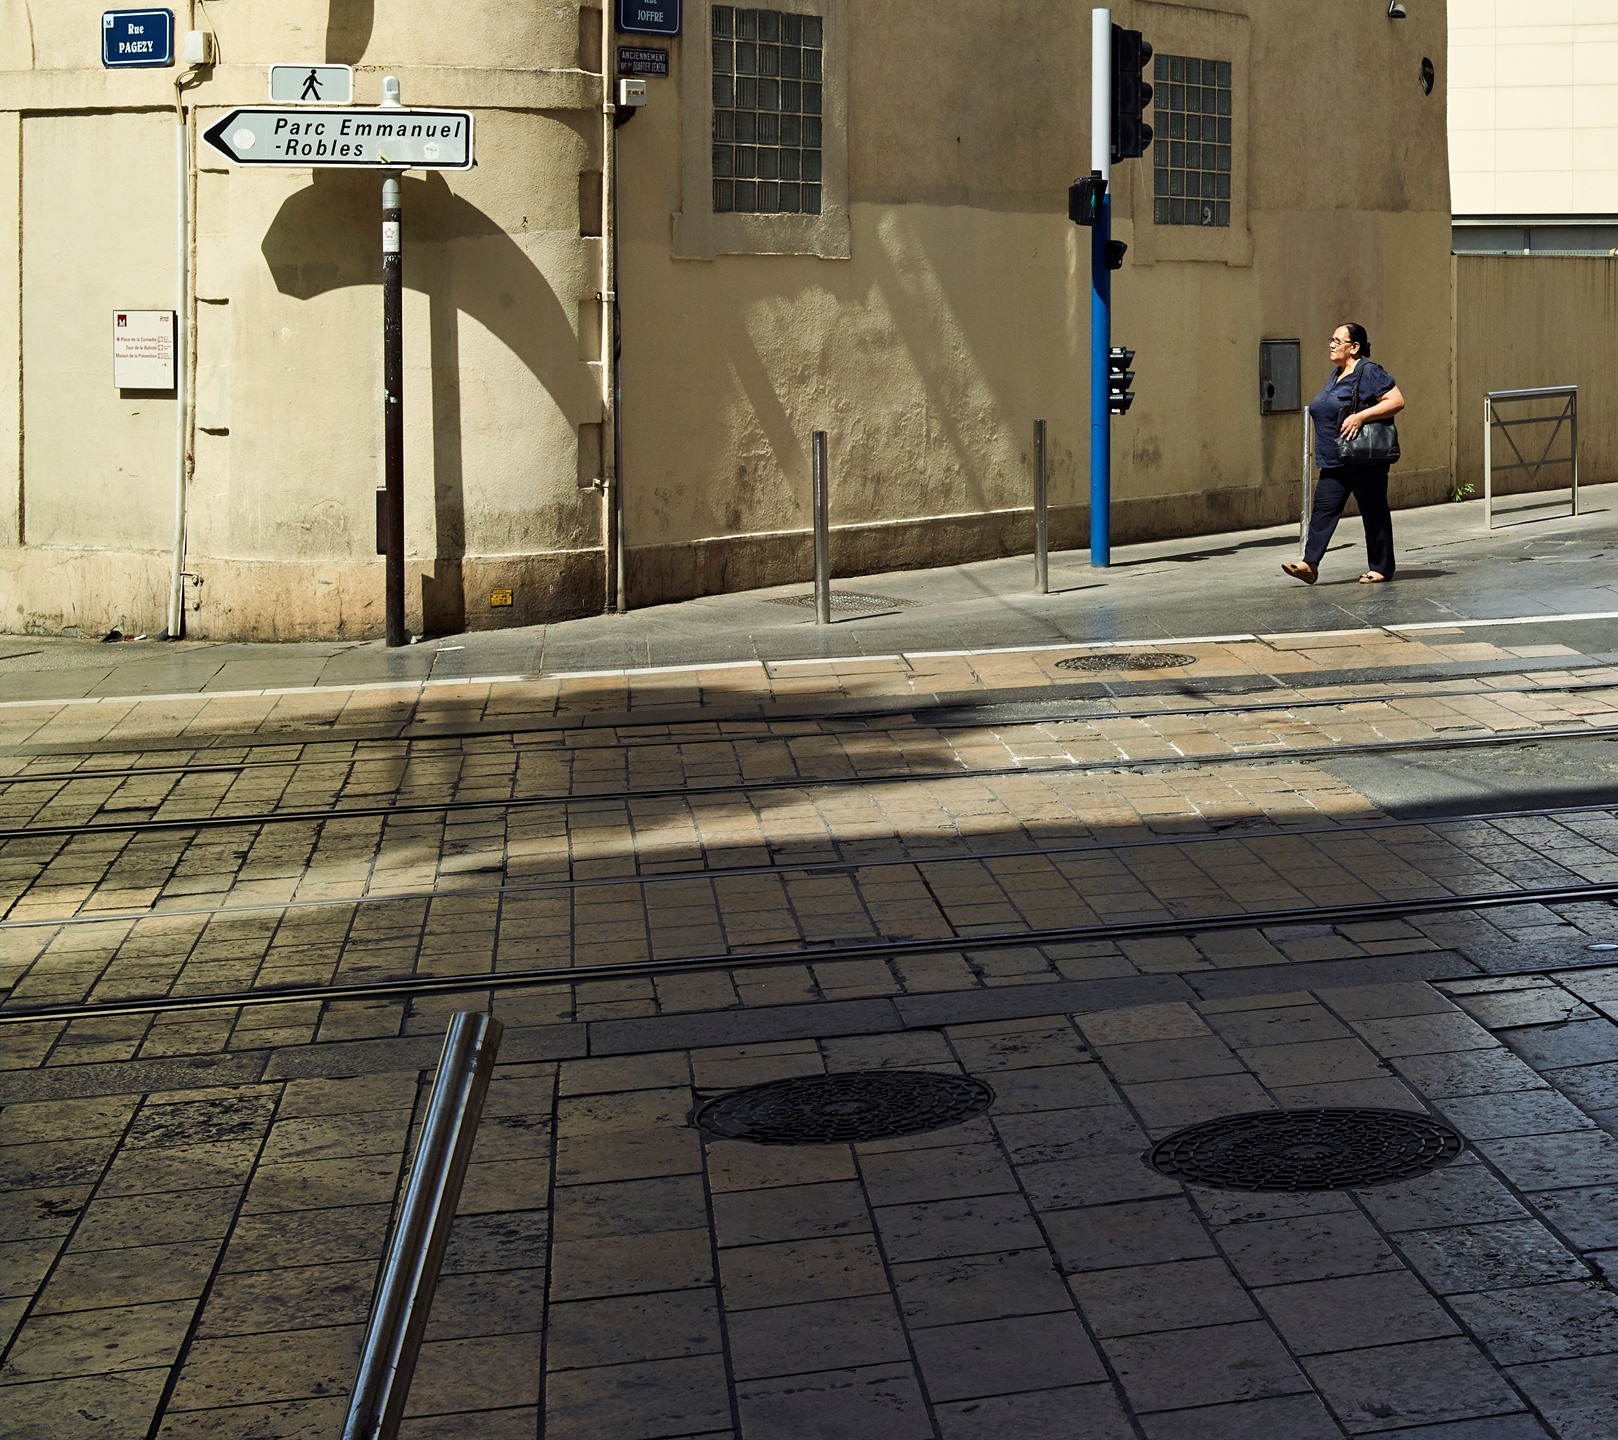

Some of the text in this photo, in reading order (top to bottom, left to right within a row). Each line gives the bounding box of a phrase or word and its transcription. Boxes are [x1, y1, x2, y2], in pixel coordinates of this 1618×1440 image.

[637, 9, 664, 22] JOFFRE
[127, 23, 145, 35] Rue
[118, 40, 154, 54] PAGEZY
[621, 51, 666, 62] ANCIENNEMENT
[274, 117, 461, 138] Parc Emmanuel
[275, 138, 364, 157] -Robles
